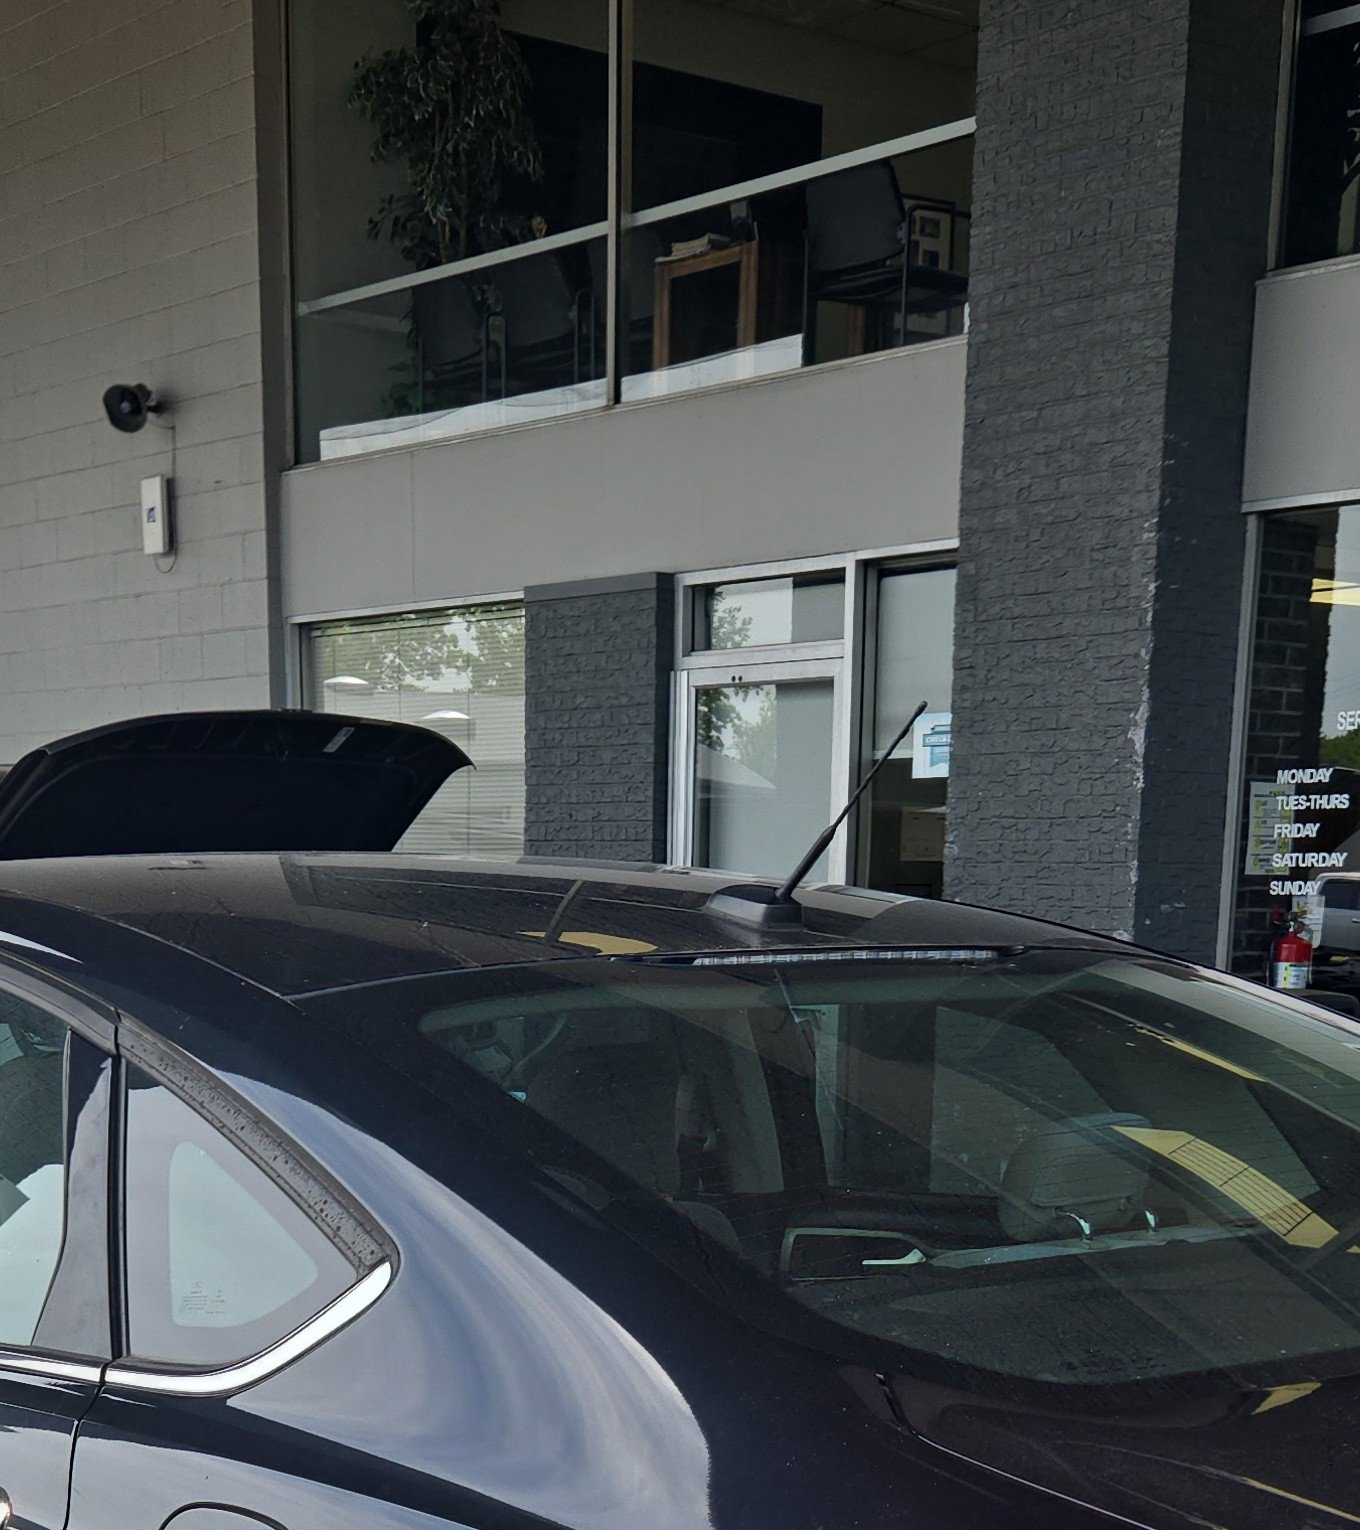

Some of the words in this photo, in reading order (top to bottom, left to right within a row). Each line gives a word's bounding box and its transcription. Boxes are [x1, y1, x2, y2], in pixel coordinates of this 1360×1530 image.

[1276, 767, 1333, 784] MONDAY
[1275, 793, 1350, 811] TUES-THURS
[1273, 822, 1320, 839] FRIDAY
[1271, 851, 1347, 868] SATURDAY
[1269, 879, 1321, 897] SUNDAY
